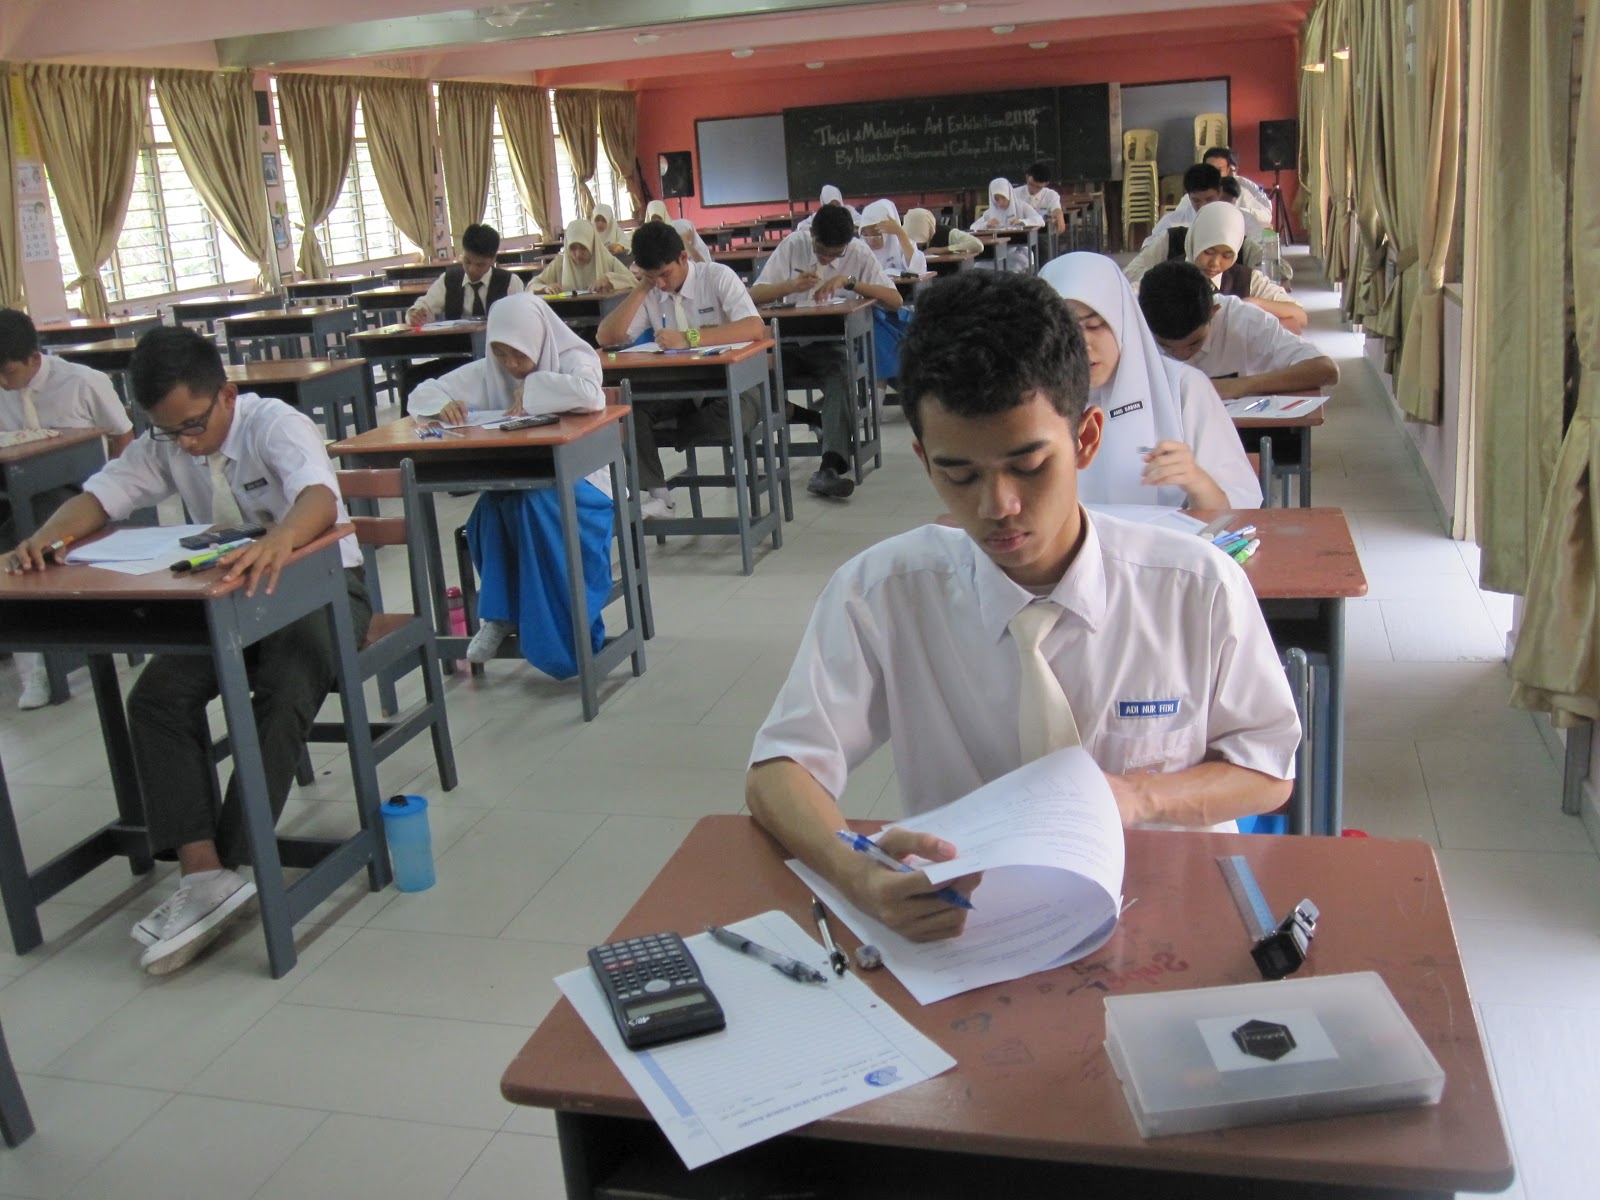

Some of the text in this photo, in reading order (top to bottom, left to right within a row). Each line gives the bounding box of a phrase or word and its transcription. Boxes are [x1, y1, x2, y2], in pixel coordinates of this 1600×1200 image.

[813, 124, 850, 146] Thai
[862, 119, 917, 147] Malaysia
[923, 116, 943, 136] Art
[947, 114, 1005, 134] Exhibition
[835, 149, 854, 170] By
[949, 139, 981, 159] College
[991, 136, 1009, 153] Fine
[1009, 135, 1031, 152] Arts
[1126, 704, 1174, 714] ADI NUR FITRI
